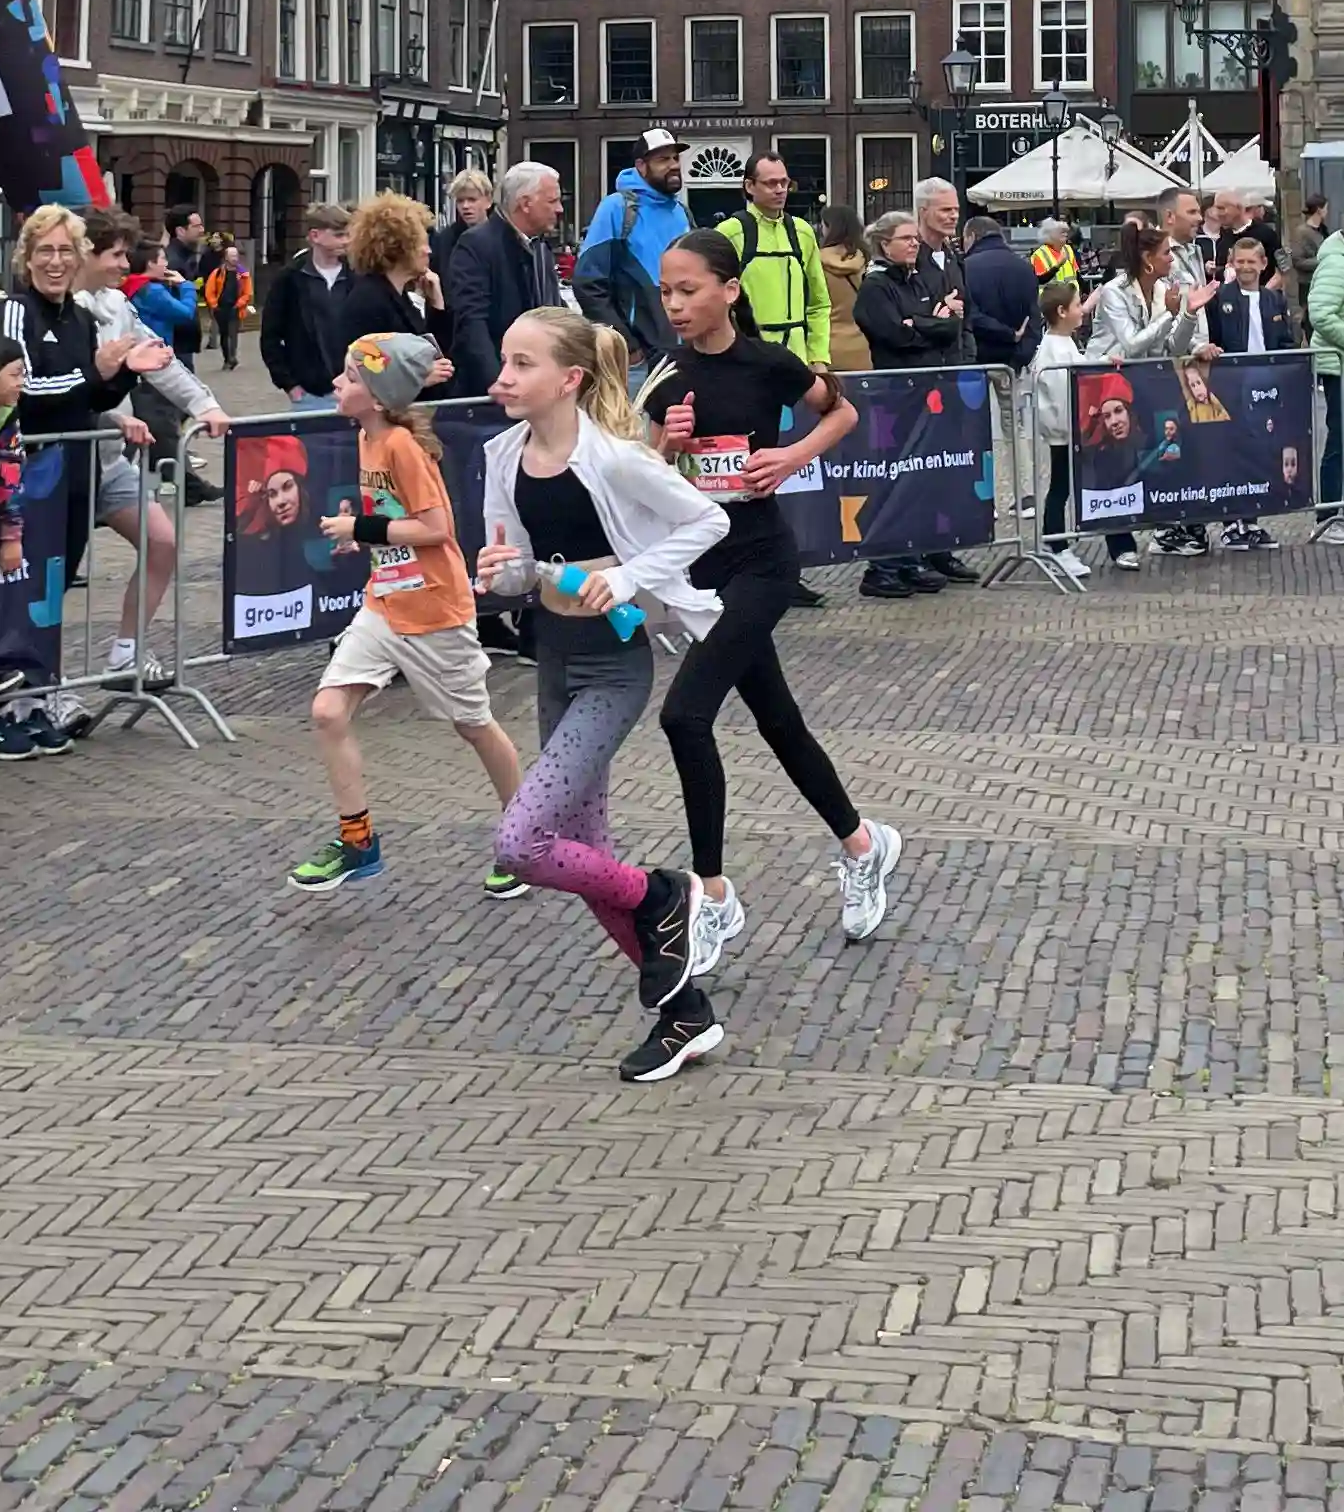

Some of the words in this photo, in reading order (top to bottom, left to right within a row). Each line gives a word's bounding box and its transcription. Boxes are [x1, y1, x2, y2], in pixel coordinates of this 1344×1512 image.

[975, 113, 1071, 129] BOTERHUS
[999, 191, 1045, 200] BOTERHUIS
[701, 454, 745, 474] 3716
[853, 459, 888, 479] kind,
[925, 454, 942, 469] en
[942, 449, 975, 468] buurt
[1089, 492, 1136, 513] gro-up
[1149, 490, 1180, 504] Voor
[1180, 486, 1209, 502] kind,
[1209, 485, 1236, 503] gezin
[1236, 485, 1248, 495] en
[319, 593, 353, 613] Voor
[244, 600, 305, 628] gro-up
